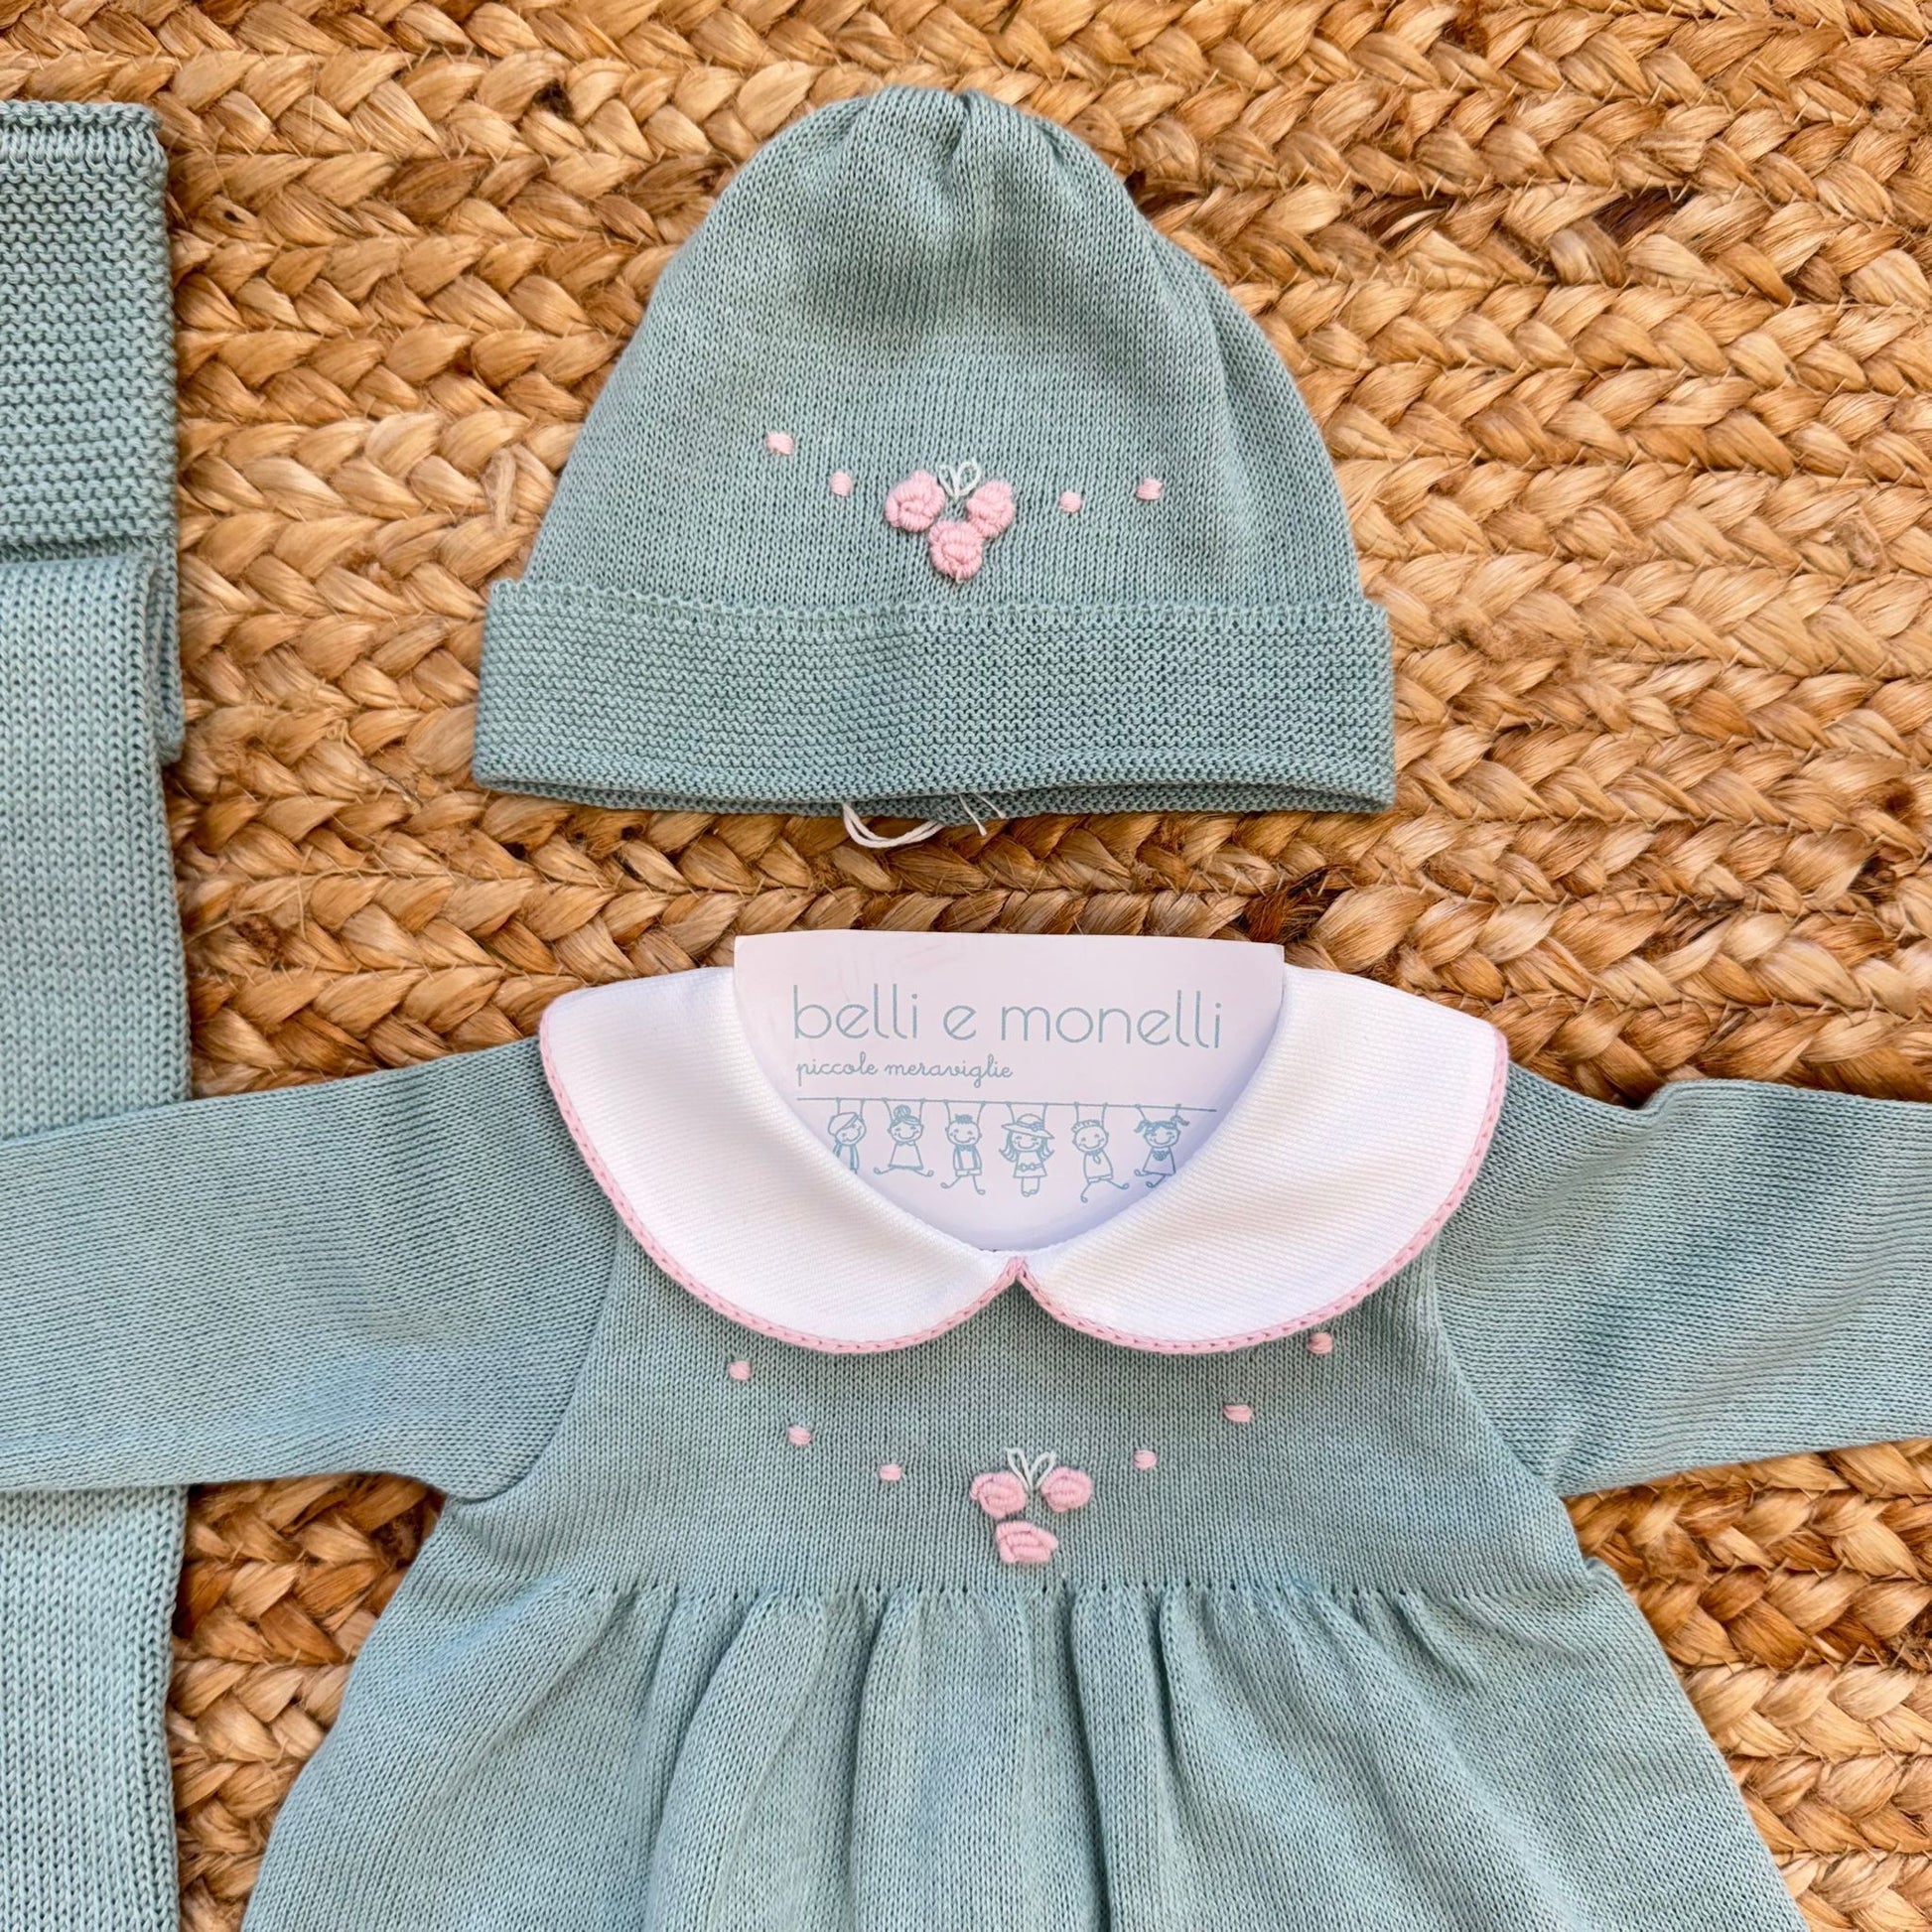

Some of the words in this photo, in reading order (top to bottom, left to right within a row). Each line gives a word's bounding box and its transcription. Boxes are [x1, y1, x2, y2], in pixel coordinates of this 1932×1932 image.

[793, 983, 918, 1040] belli
[942, 1005, 977, 1041] e
[1001, 990, 1222, 1049] monelli
[795, 1050, 879, 1087] piccole
[884, 1052, 1014, 1089] meraviglie
